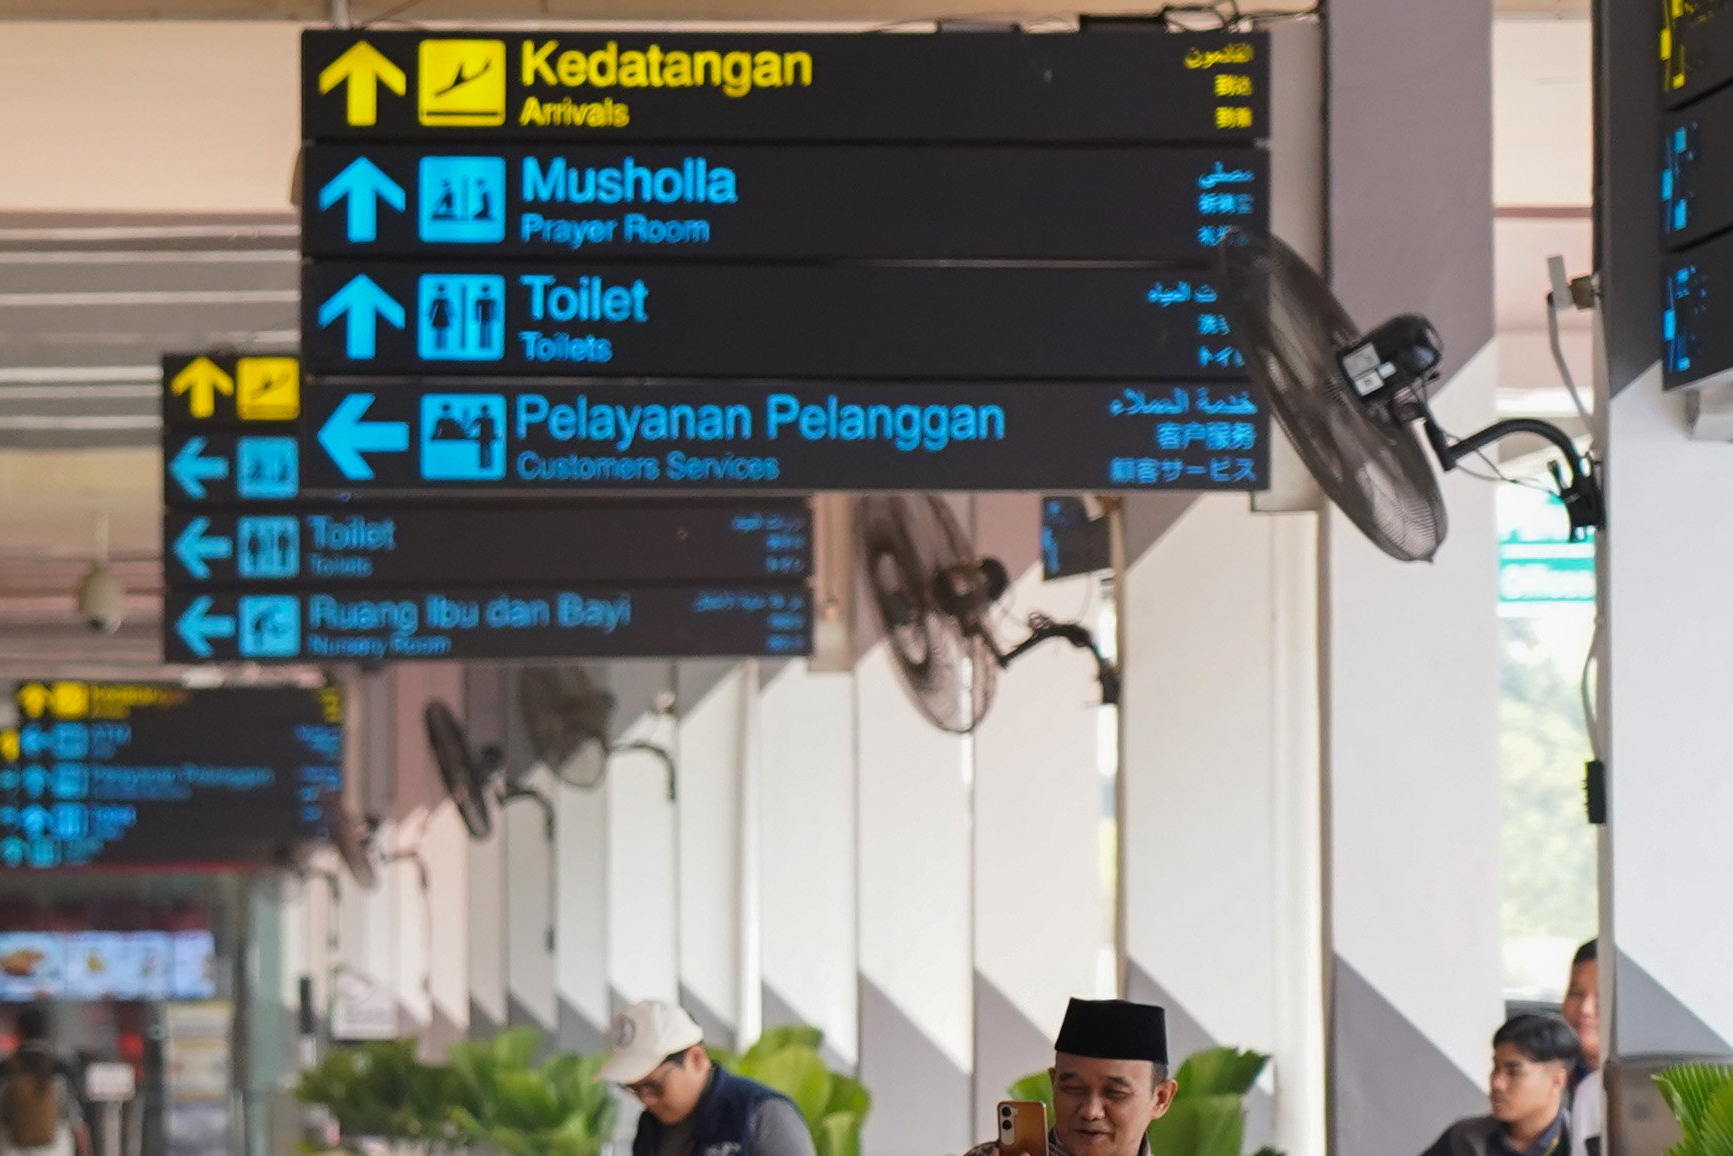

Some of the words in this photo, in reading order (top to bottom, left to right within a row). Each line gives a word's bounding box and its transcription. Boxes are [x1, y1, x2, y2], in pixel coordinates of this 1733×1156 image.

[521, 40, 812, 97] Kedatangan
[520, 97, 629, 127] Arrivals
[521, 156, 738, 204] Musholla
[520, 213, 617, 249] Prayer
[623, 213, 710, 243] Room
[519, 274, 648, 322] Toilet
[519, 331, 612, 362] Toilets
[516, 394, 752, 449] Pelayanan
[767, 394, 1005, 451] Pelanggan
[516, 452, 660, 480] Customers
[666, 451, 779, 480] Services
[307, 515, 395, 550] Toilet
[308, 594, 419, 635] Ruang
[425, 594, 480, 629] Ibu
[484, 595, 550, 629] dan
[556, 592, 631, 633] Bayi
